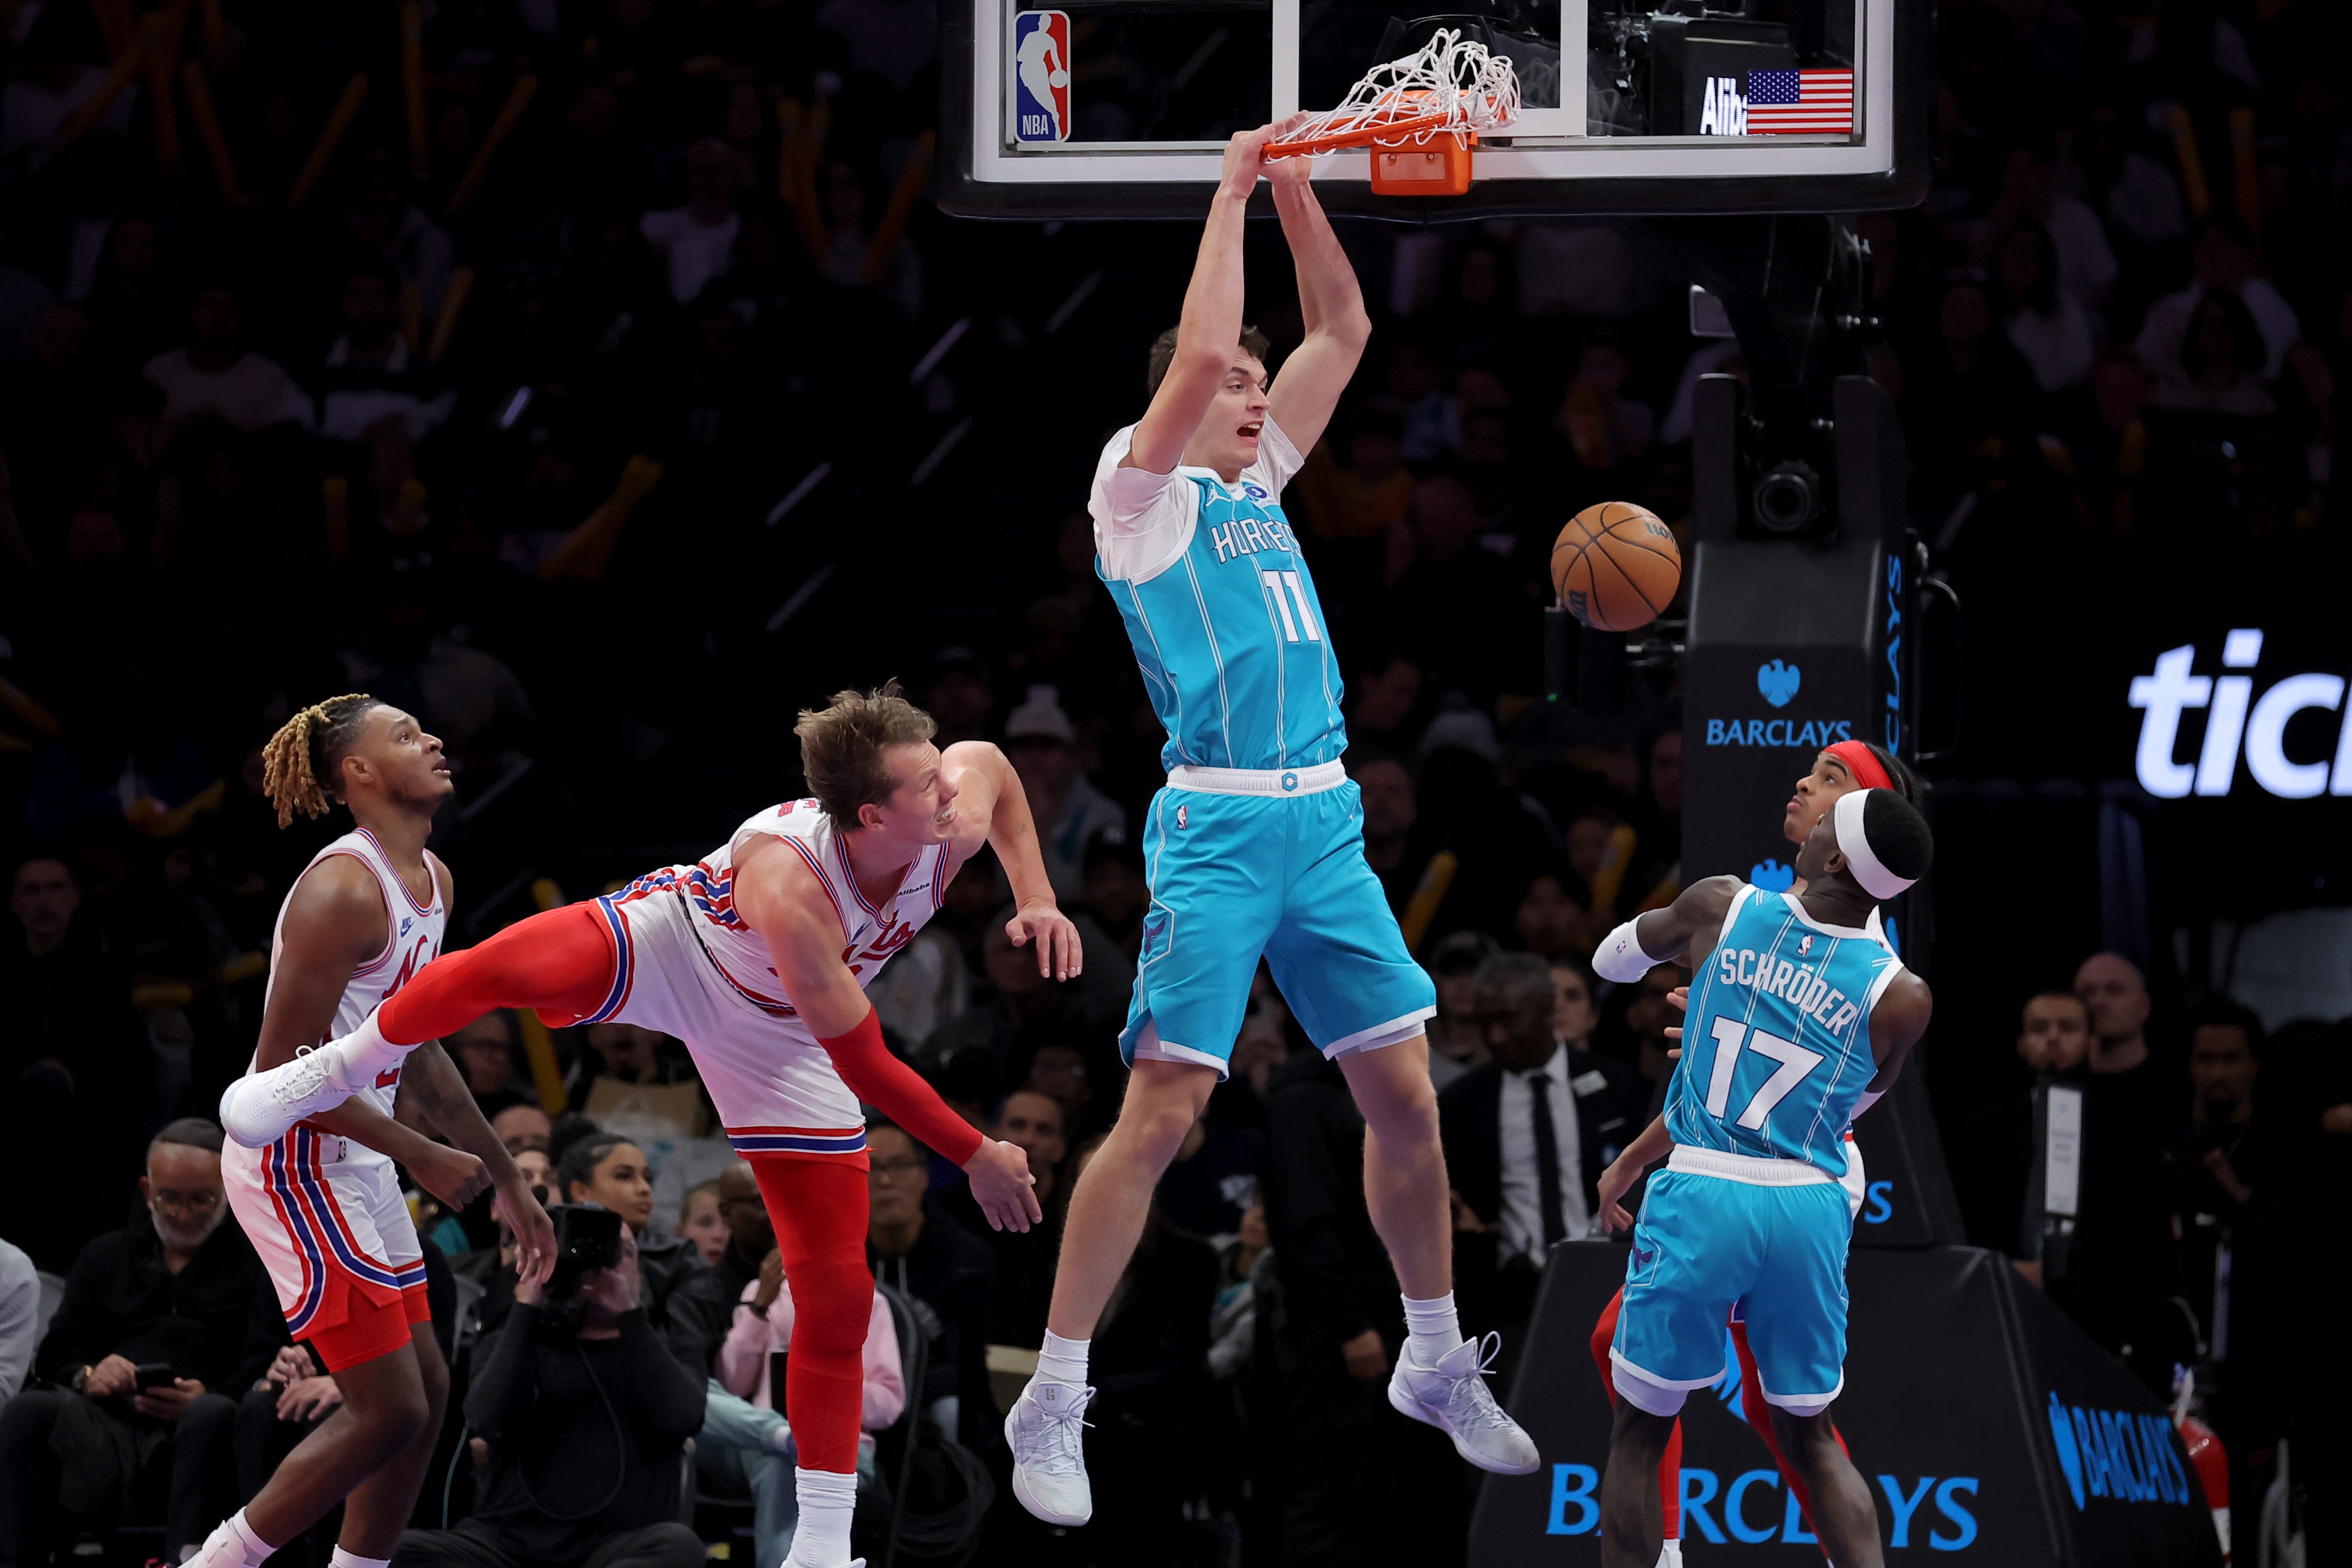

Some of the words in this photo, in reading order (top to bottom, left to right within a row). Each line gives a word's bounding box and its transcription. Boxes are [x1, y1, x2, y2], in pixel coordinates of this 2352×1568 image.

[1022, 114, 1050, 135] NBA
[1262, 570, 1321, 643] 11
[1885, 554, 1902, 756] CLAYS
[1706, 718, 1852, 747] BARCLAYS
[2127, 628, 2352, 800] tic
[1720, 948, 1858, 1037] SCHRÖDER
[1704, 1014, 1827, 1132] 17
[2072, 1406, 2190, 1506] BARCLAYS
[1545, 1462, 1979, 1552] BRCLYS
